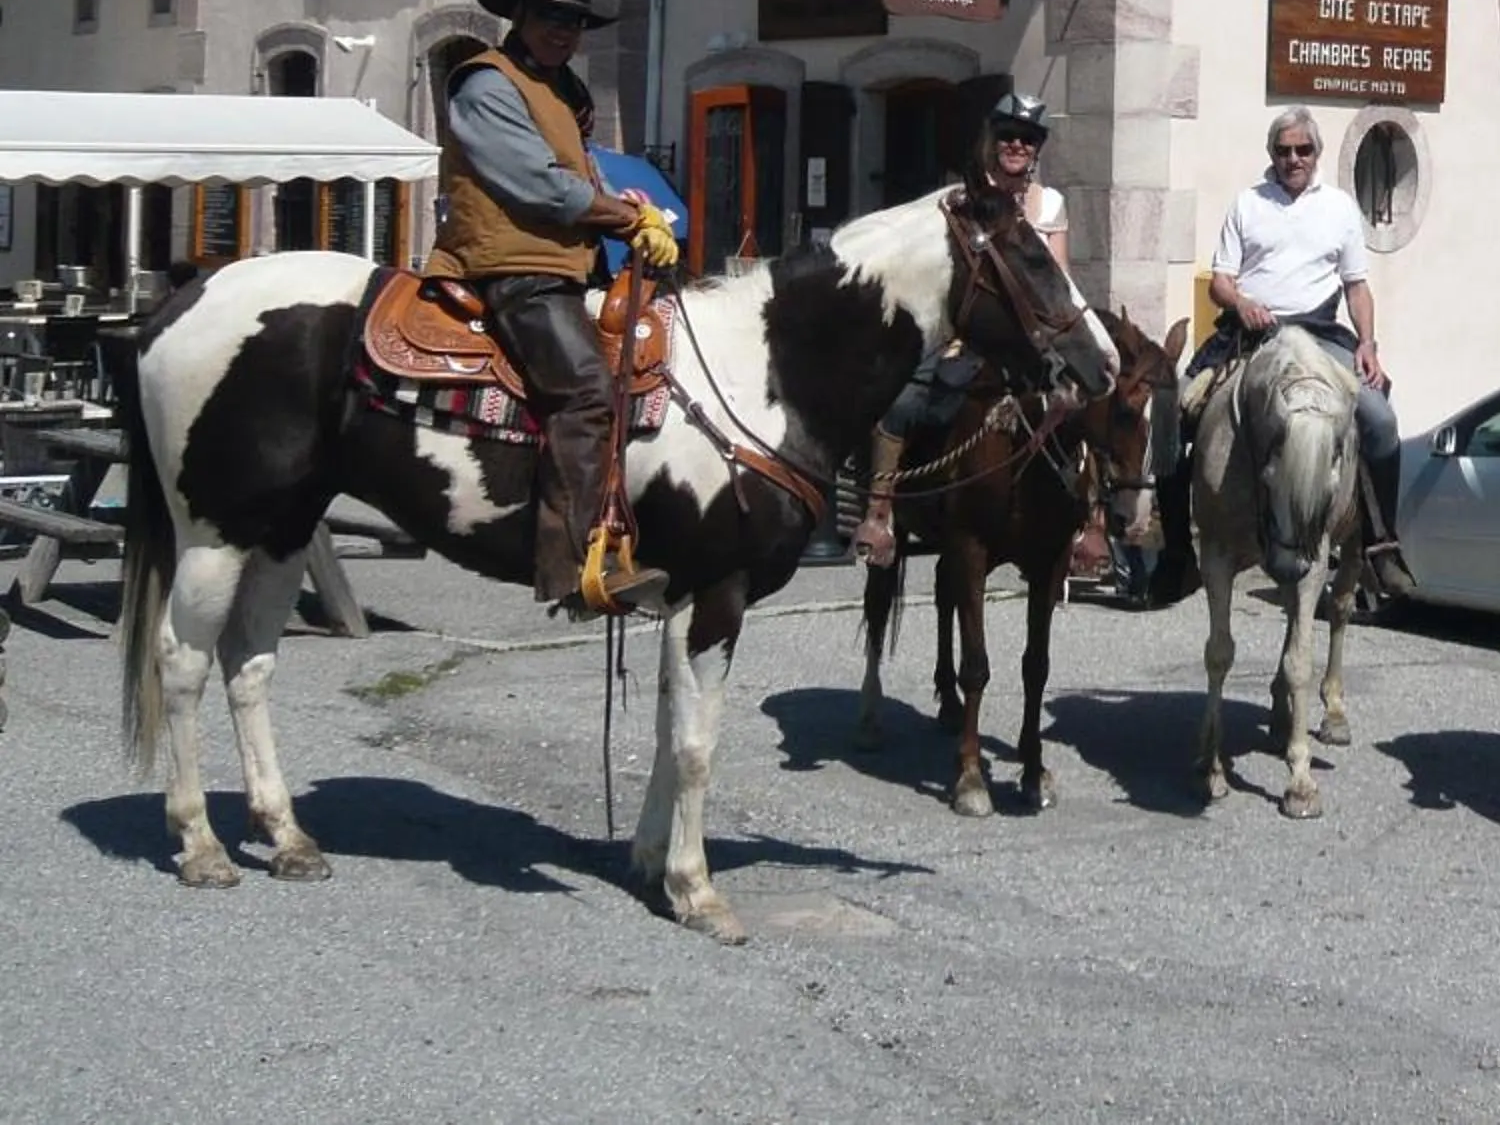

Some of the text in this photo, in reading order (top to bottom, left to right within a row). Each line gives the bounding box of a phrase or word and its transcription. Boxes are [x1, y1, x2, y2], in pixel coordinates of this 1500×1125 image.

[1368, 2, 1432, 28] D'ETAPE
[1289, 40, 1432, 72] CHAMBRES REPAS
[1371, 81, 1407, 94] MOTO
